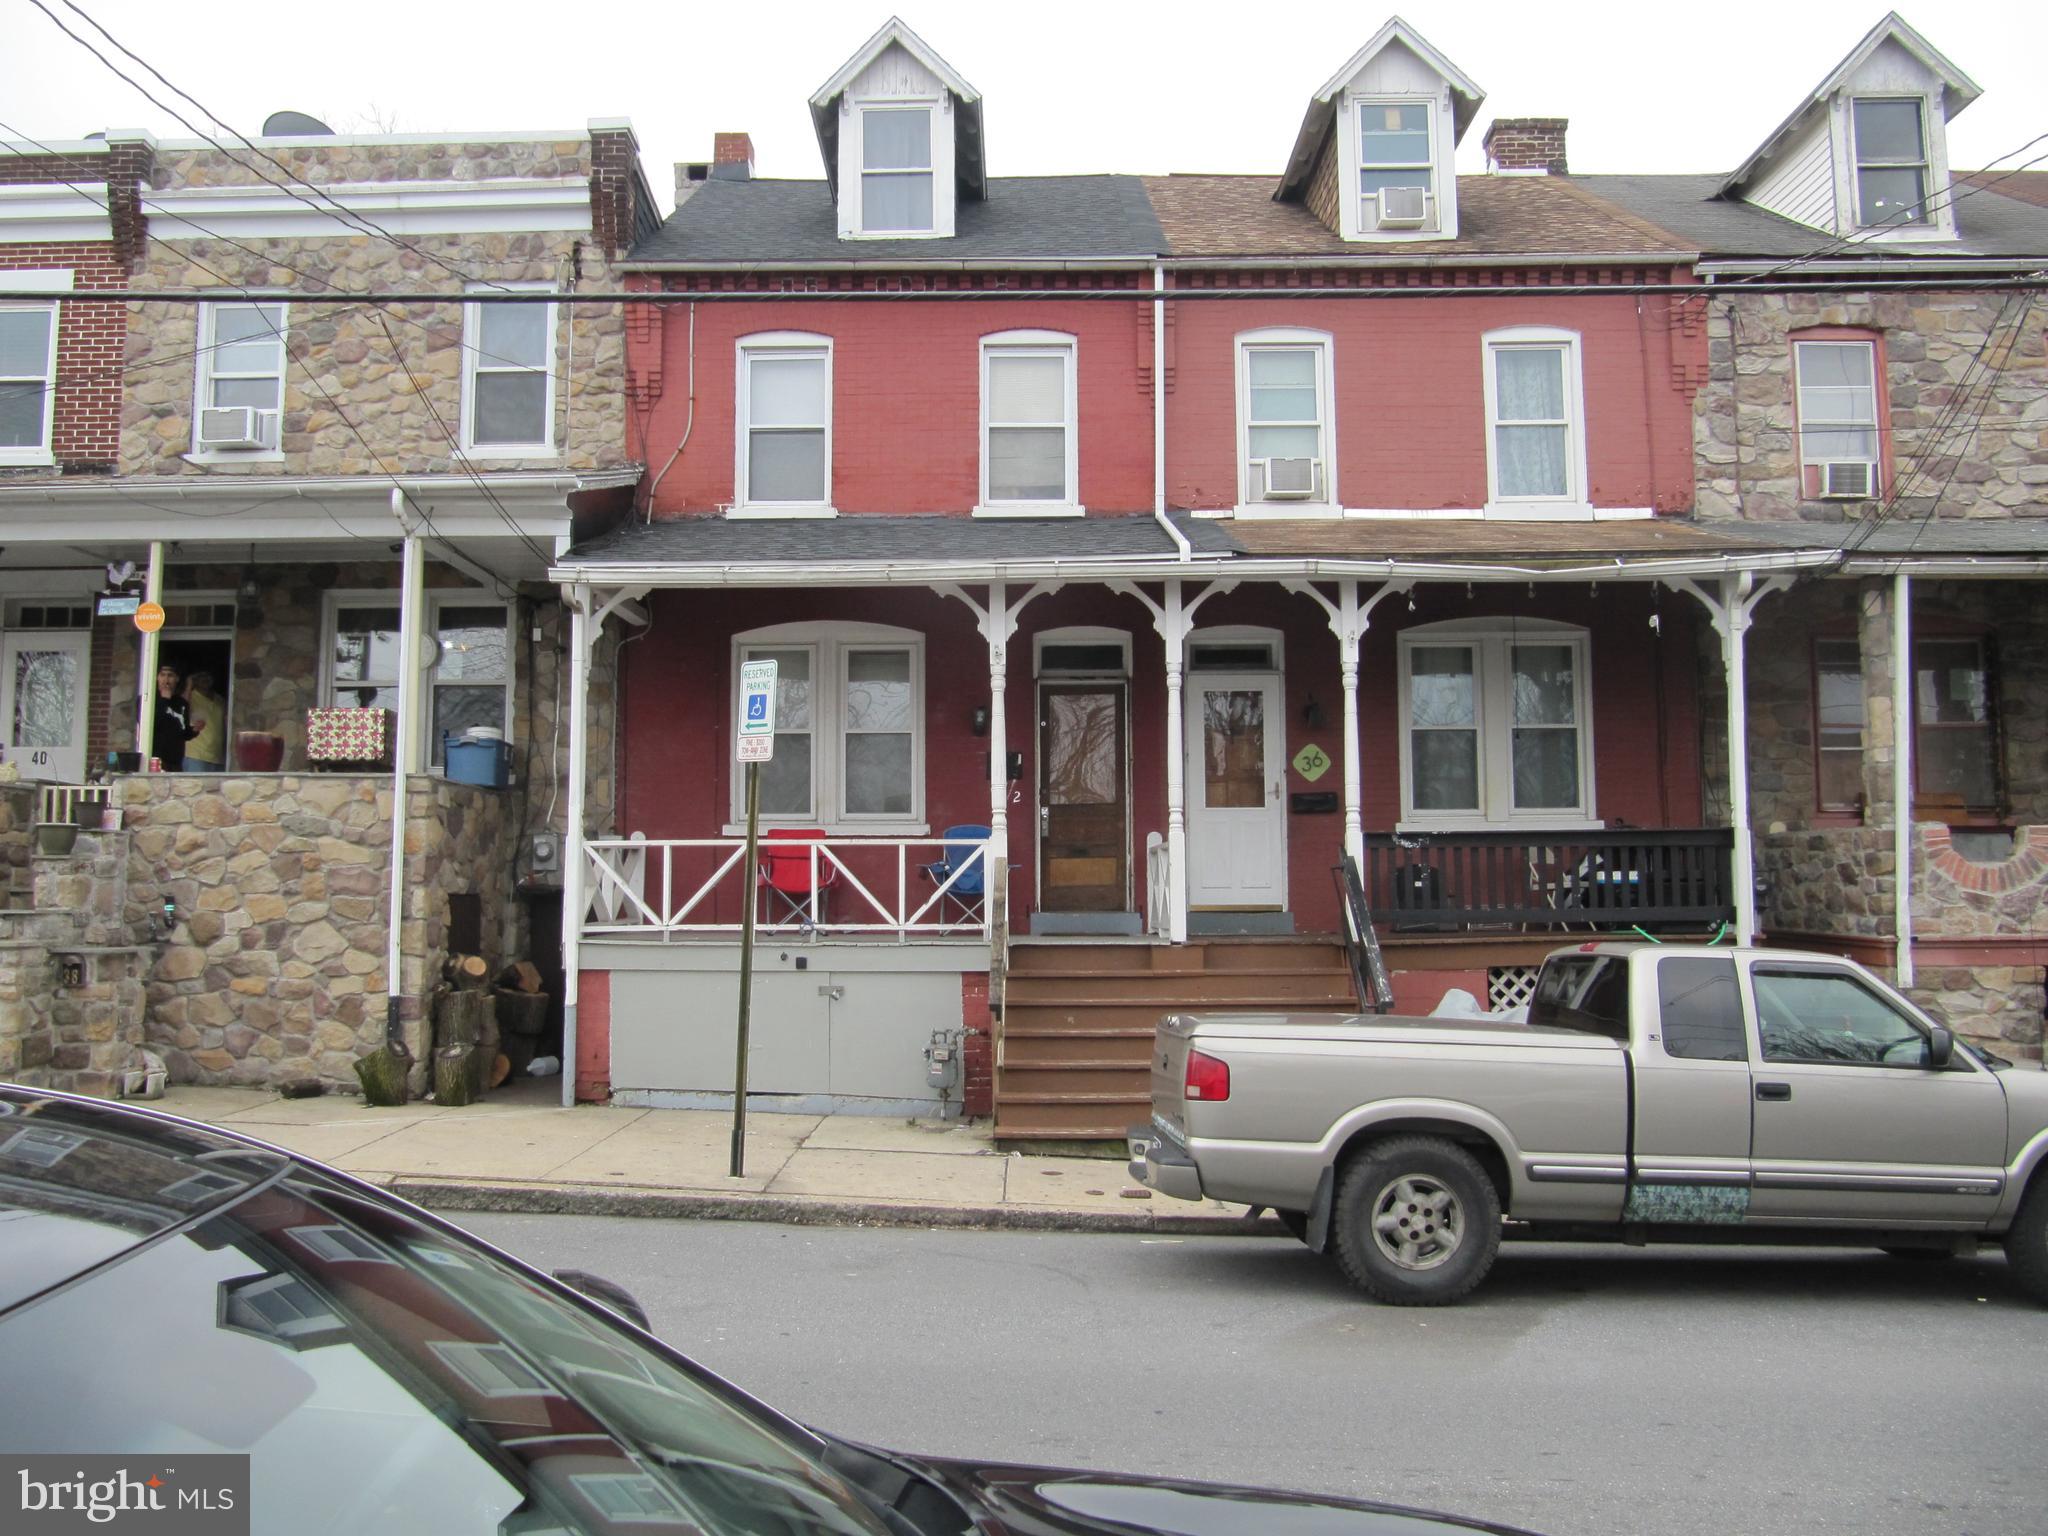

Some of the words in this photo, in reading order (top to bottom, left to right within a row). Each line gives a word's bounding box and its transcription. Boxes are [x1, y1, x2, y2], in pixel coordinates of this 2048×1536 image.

[744, 667, 774, 679] RESERVED
[746, 681, 770, 691] PARKING
[32, 751, 47, 765] 40
[1301, 751, 1323, 772] 36
